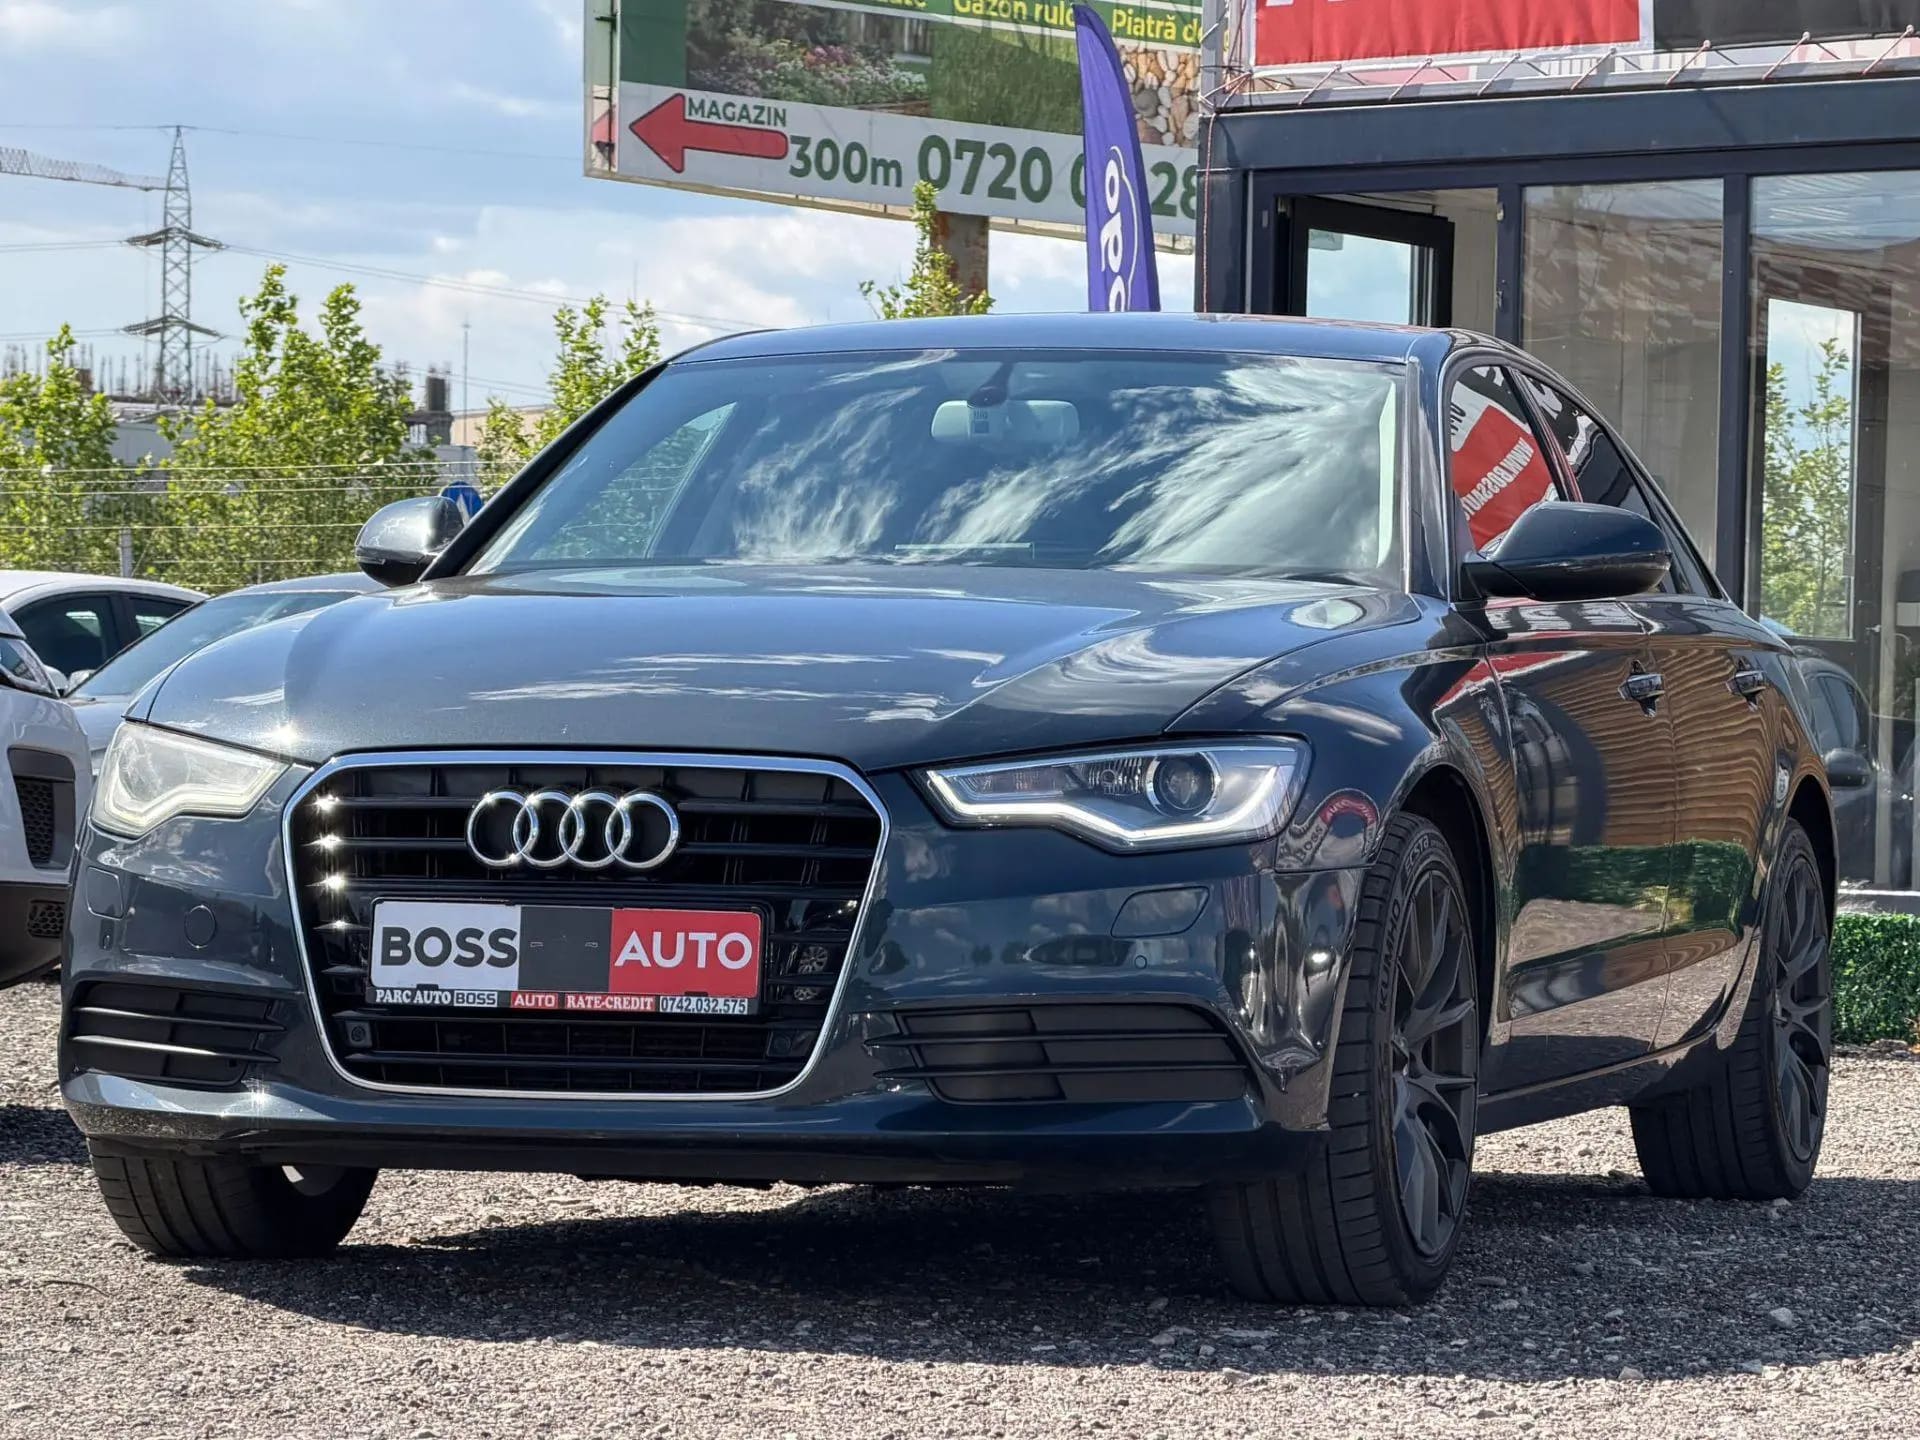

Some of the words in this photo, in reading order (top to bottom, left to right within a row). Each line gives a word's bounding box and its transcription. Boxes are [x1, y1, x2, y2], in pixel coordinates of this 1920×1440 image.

[952, 0, 1028, 21] Gazon
[1111, 8, 1176, 41] Piatră
[688, 96, 786, 127] MAGAZIN
[789, 135, 903, 188] 300m
[917, 134, 1053, 203] 0720
[381, 926, 518, 968] BOSS
[614, 930, 753, 970] AUTO
[1379, 901, 1401, 1012] KUMHO
[375, 989, 411, 1004] PARC
[413, 989, 451, 1005] AUTO
[454, 991, 496, 1006] BOSS
[514, 993, 557, 1008] AUTO
[566, 994, 654, 1011] RATE-CREDIT
[661, 996, 746, 1014] 0742.032.575
